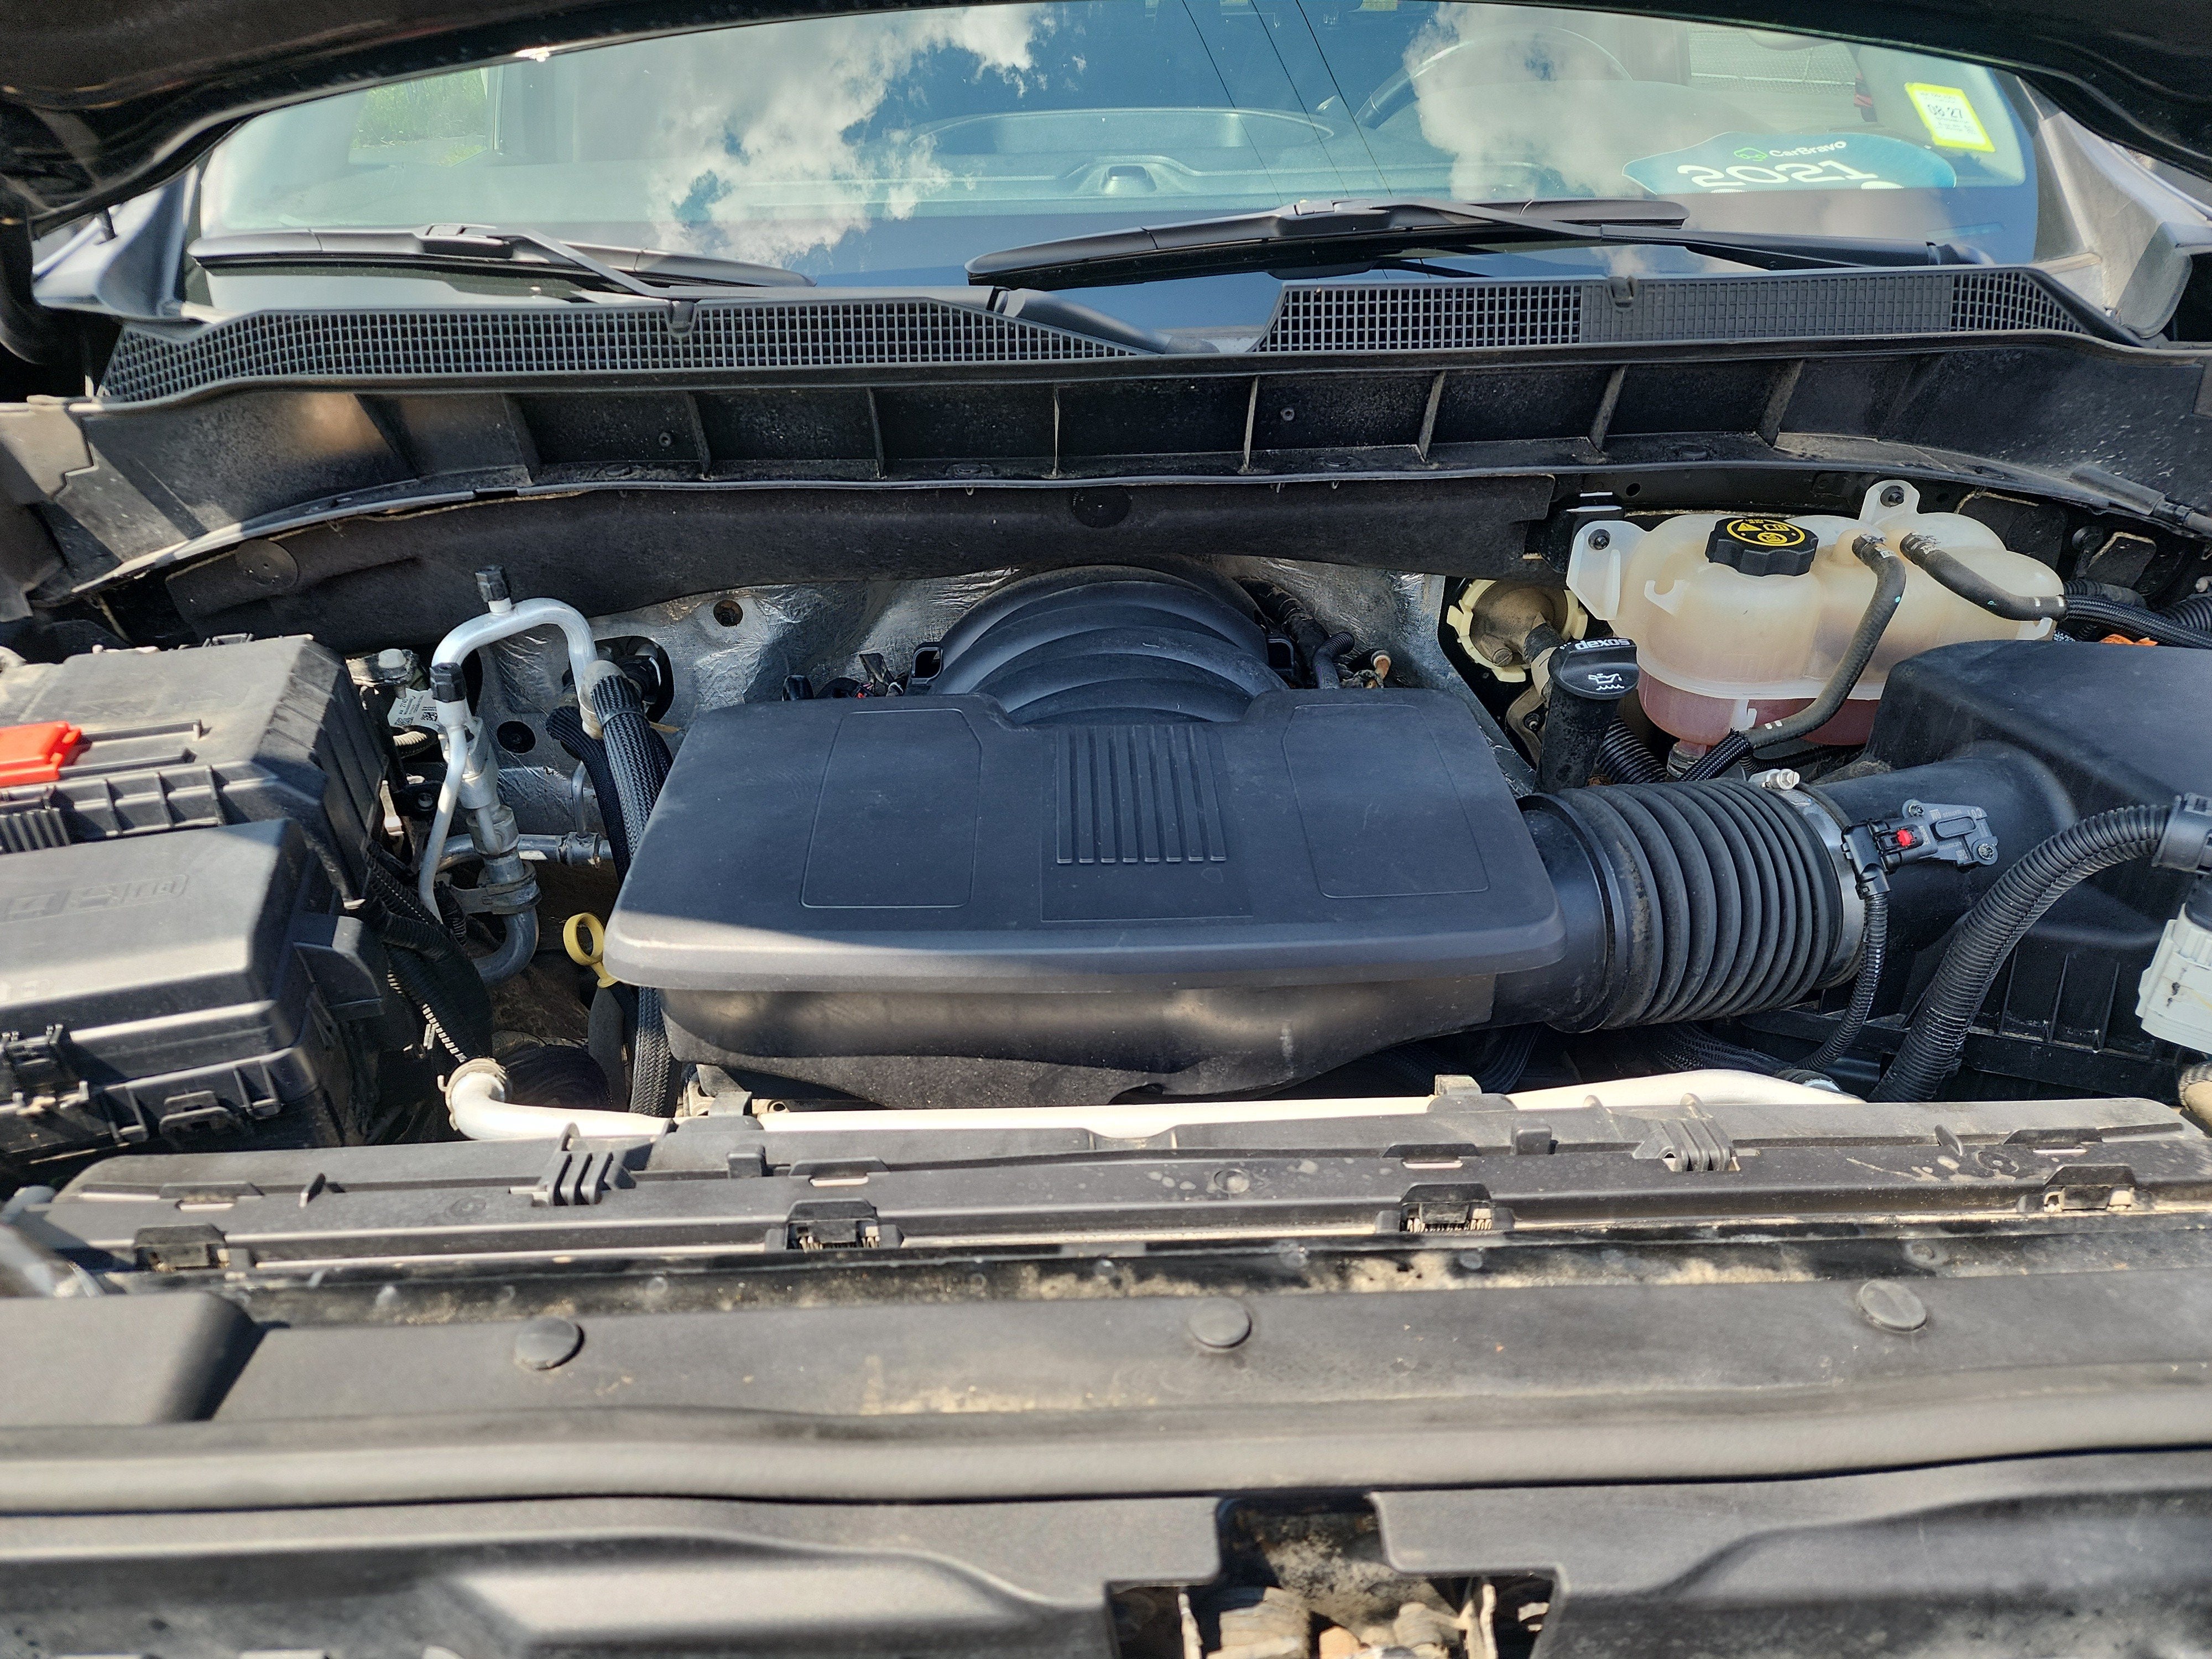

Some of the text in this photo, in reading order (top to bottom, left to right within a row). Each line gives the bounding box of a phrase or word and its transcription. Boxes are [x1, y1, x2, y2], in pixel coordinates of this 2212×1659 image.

[1768, 141, 1847, 157] CarBravo
[1677, 160, 1879, 187] 2021
[1574, 639, 1631, 650] dexos
